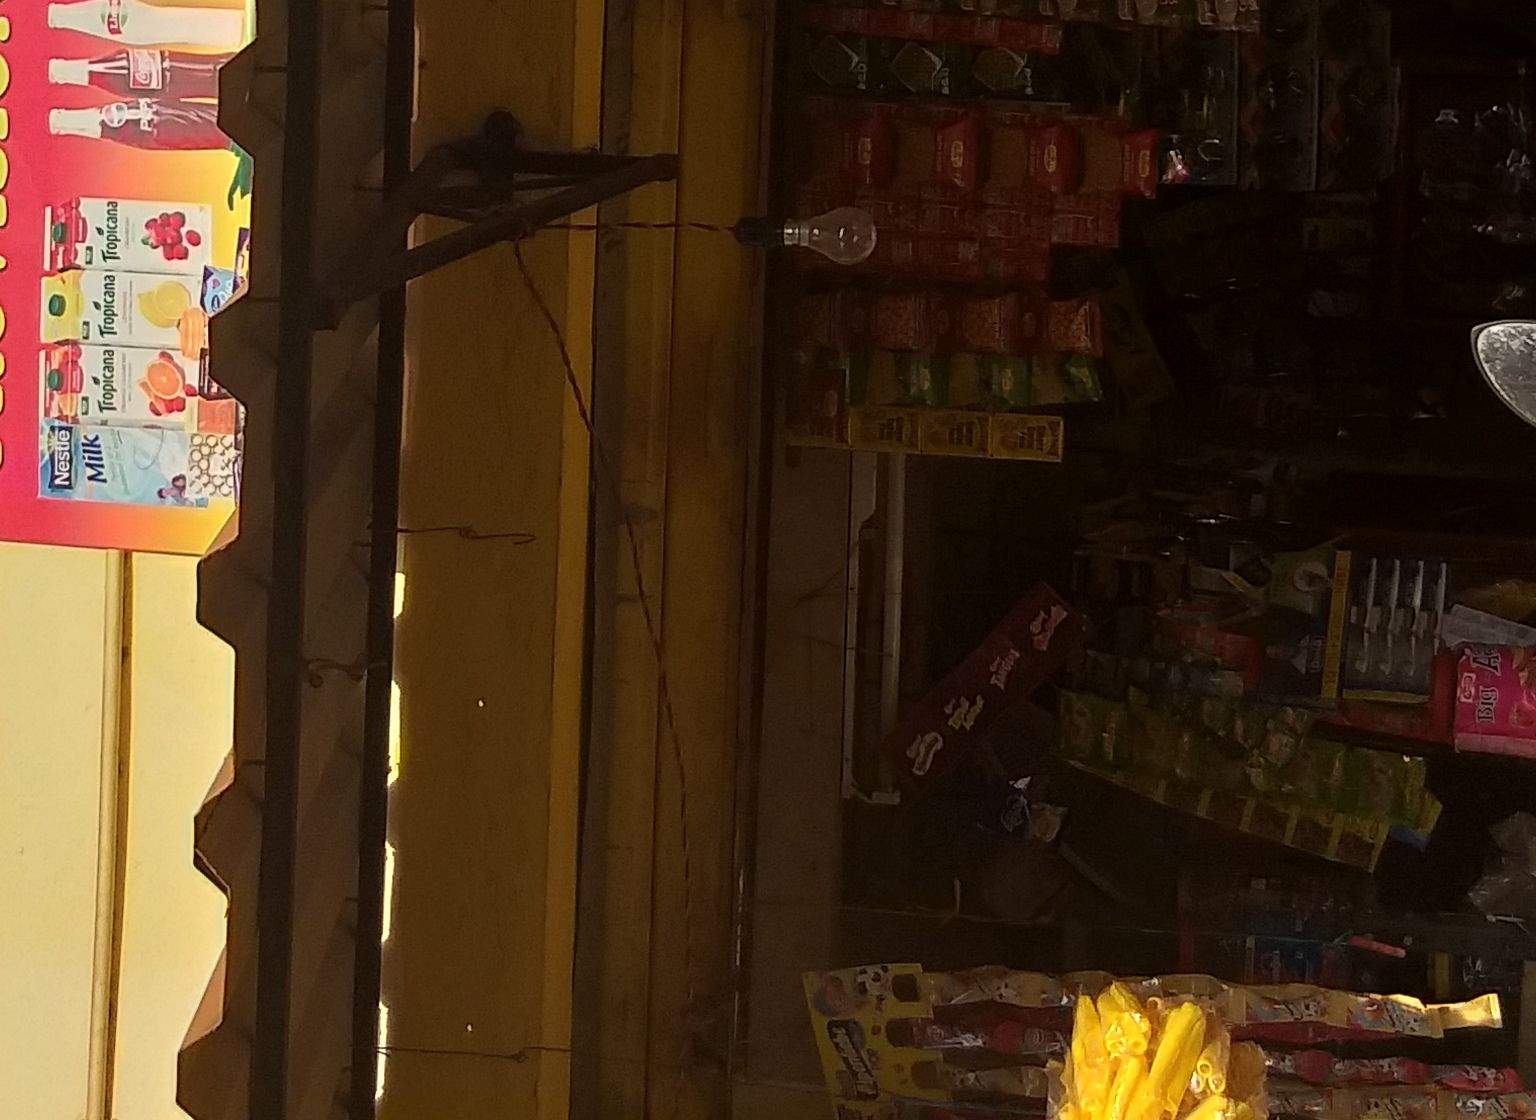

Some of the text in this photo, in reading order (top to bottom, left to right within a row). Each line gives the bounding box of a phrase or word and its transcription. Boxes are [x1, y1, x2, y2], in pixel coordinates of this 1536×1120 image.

[101, 201, 122, 263] Tropicana
[98, 274, 119, 338] Tropicana
[97, 349, 118, 414] Tropicana
[80, 434, 107, 484] Milk
